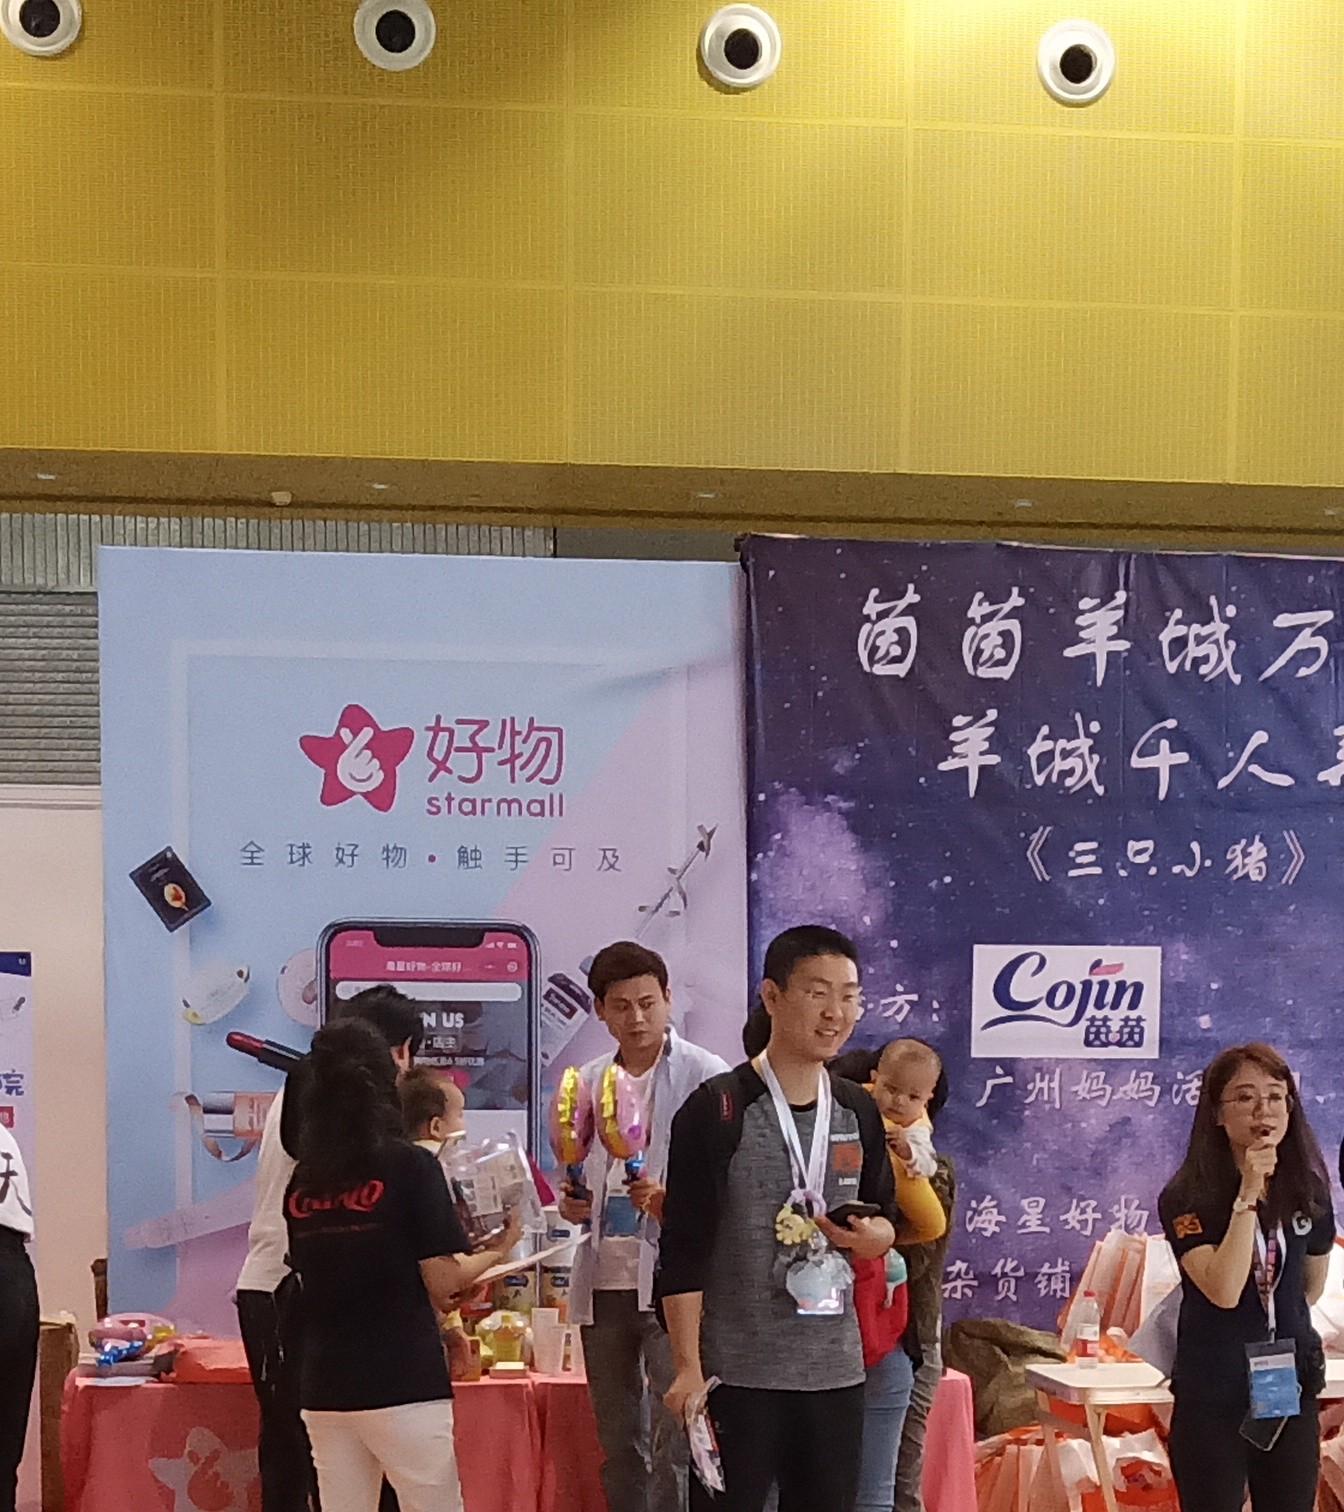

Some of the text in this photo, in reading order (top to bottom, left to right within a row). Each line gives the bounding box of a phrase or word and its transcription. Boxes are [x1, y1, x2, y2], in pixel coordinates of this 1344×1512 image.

[424, 713, 564, 785] 好物
[425, 793, 564, 818] starmall
[980, 951, 1145, 1028] Cojin
[1083, 1015, 1147, 1049] 茵茵
